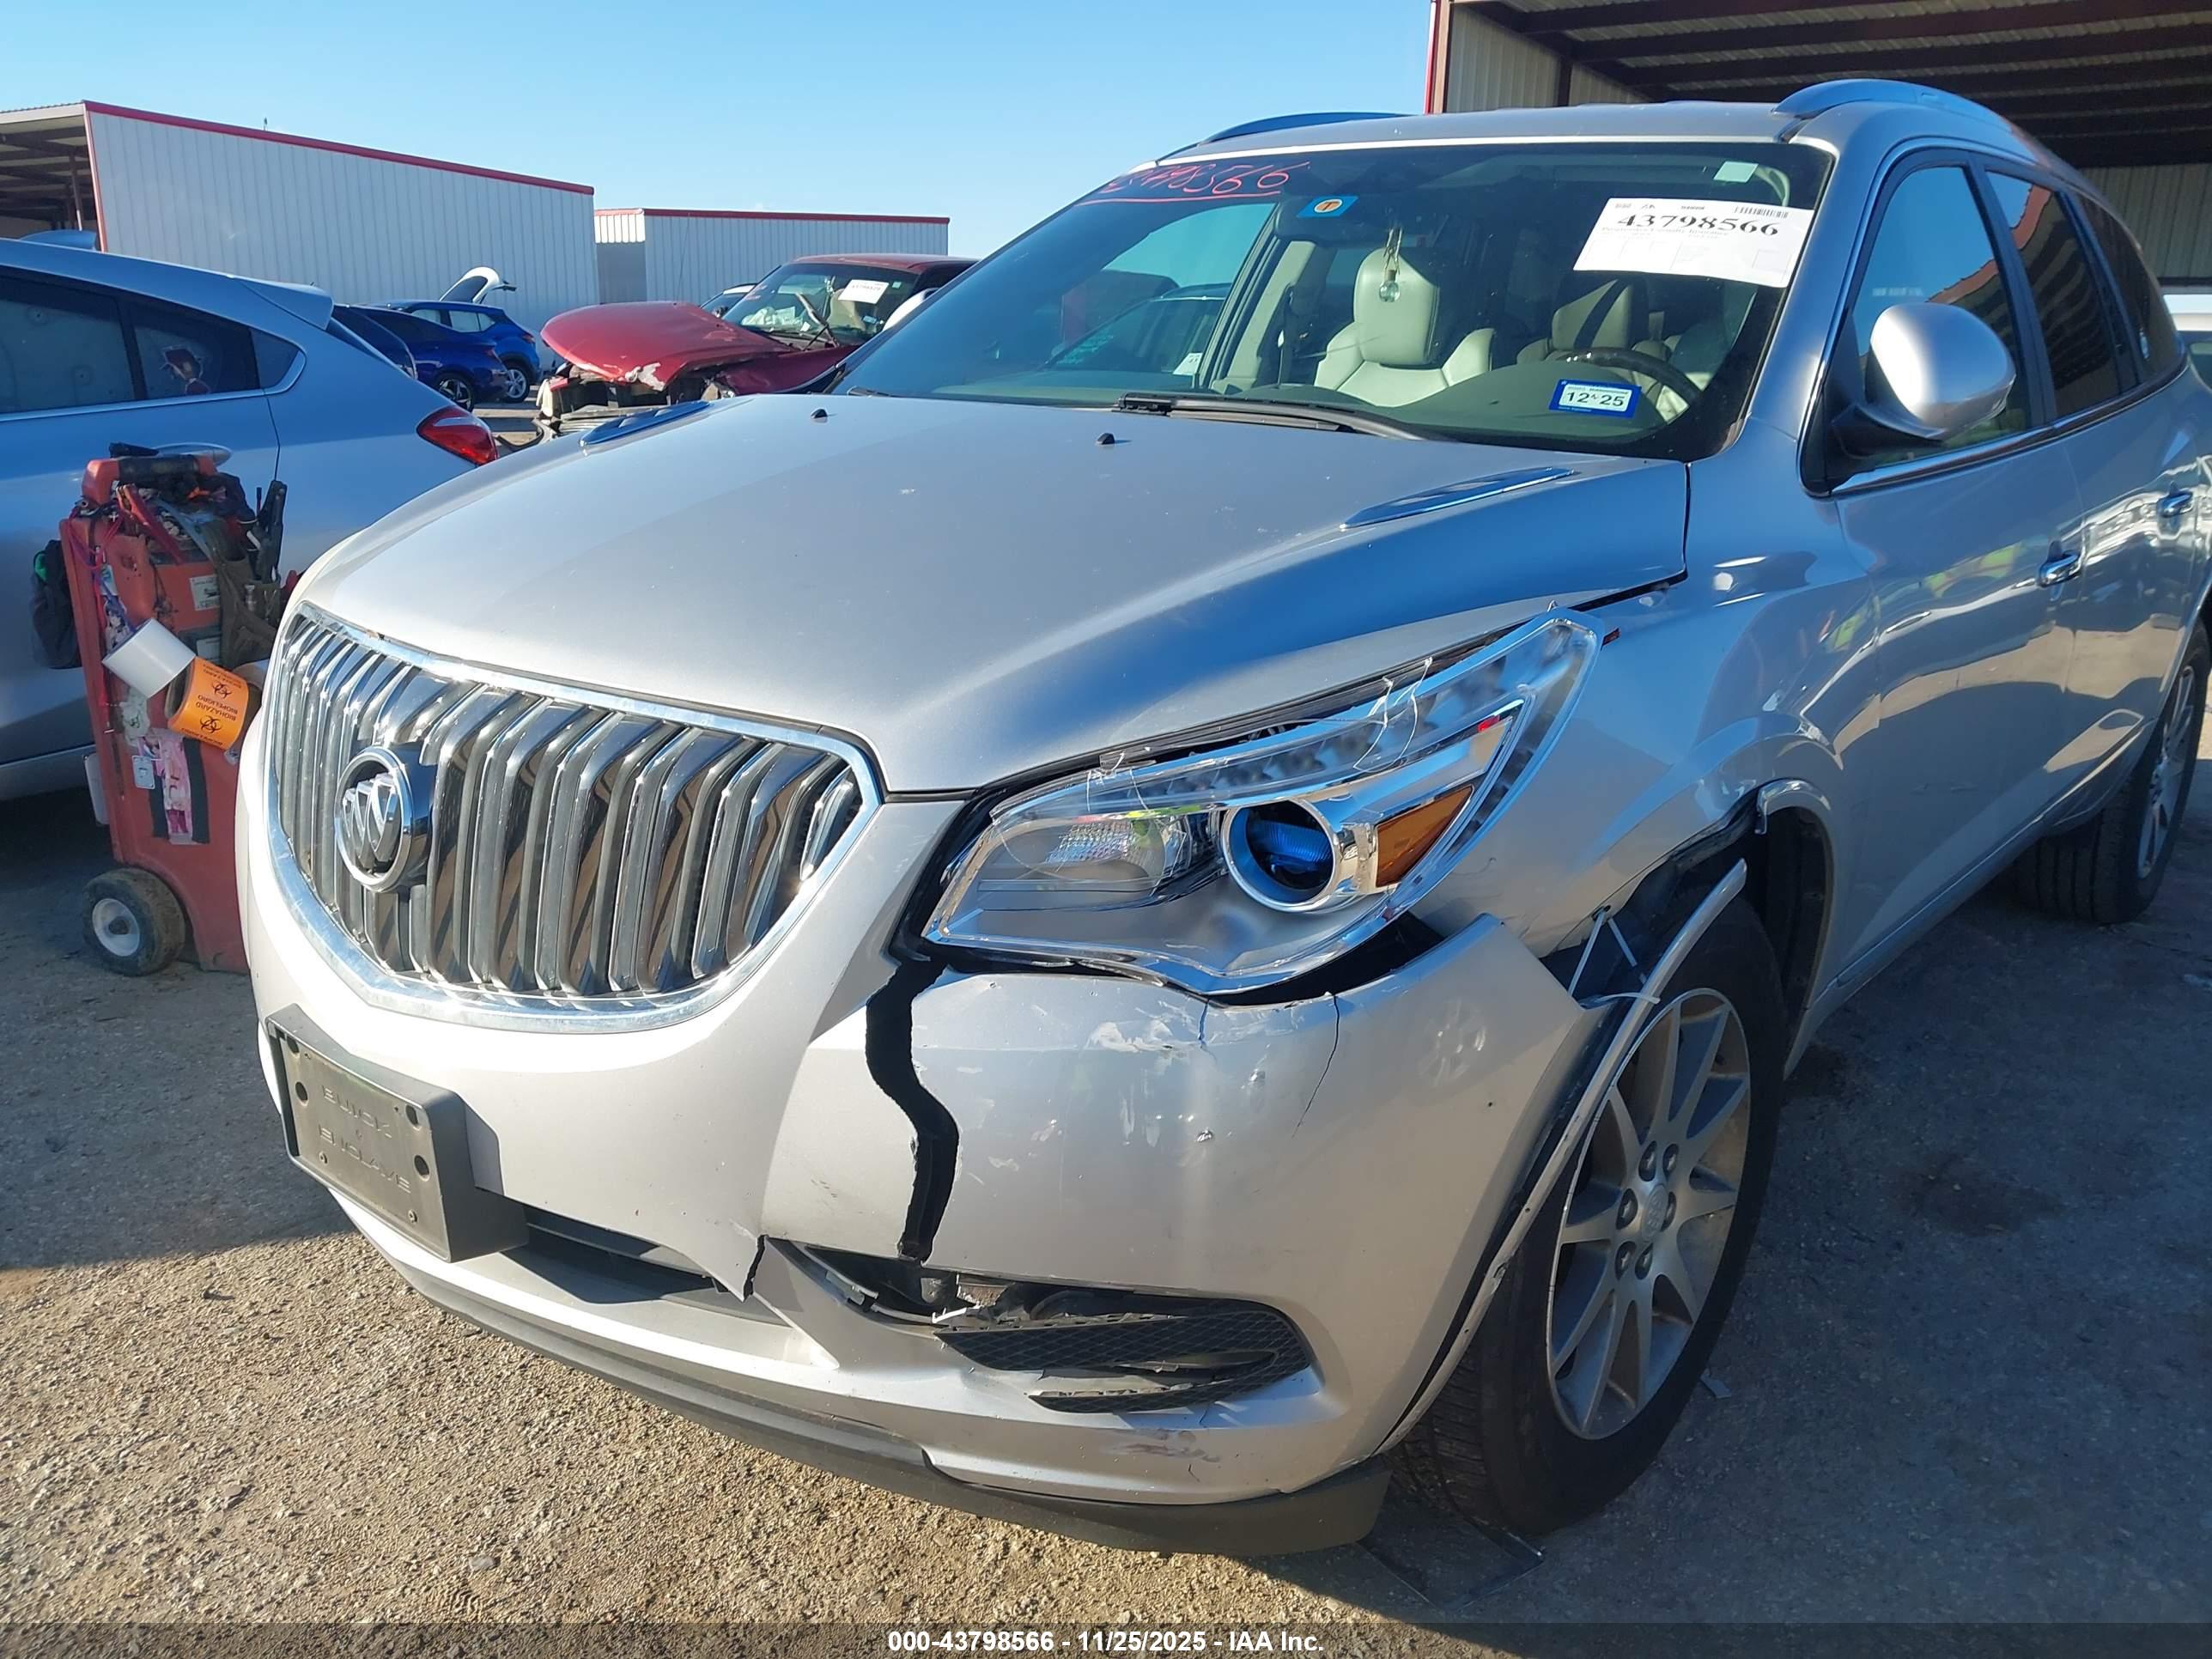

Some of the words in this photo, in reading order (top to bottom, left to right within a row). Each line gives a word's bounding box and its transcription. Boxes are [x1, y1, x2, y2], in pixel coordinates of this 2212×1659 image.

[1617, 214, 1779, 236] 43798566
[1567, 392, 1589, 404] 12
[1599, 394, 1626, 407] 25
[195, 701, 237, 721] BIOHAZARD
[322, 1085, 392, 1139] BUICK
